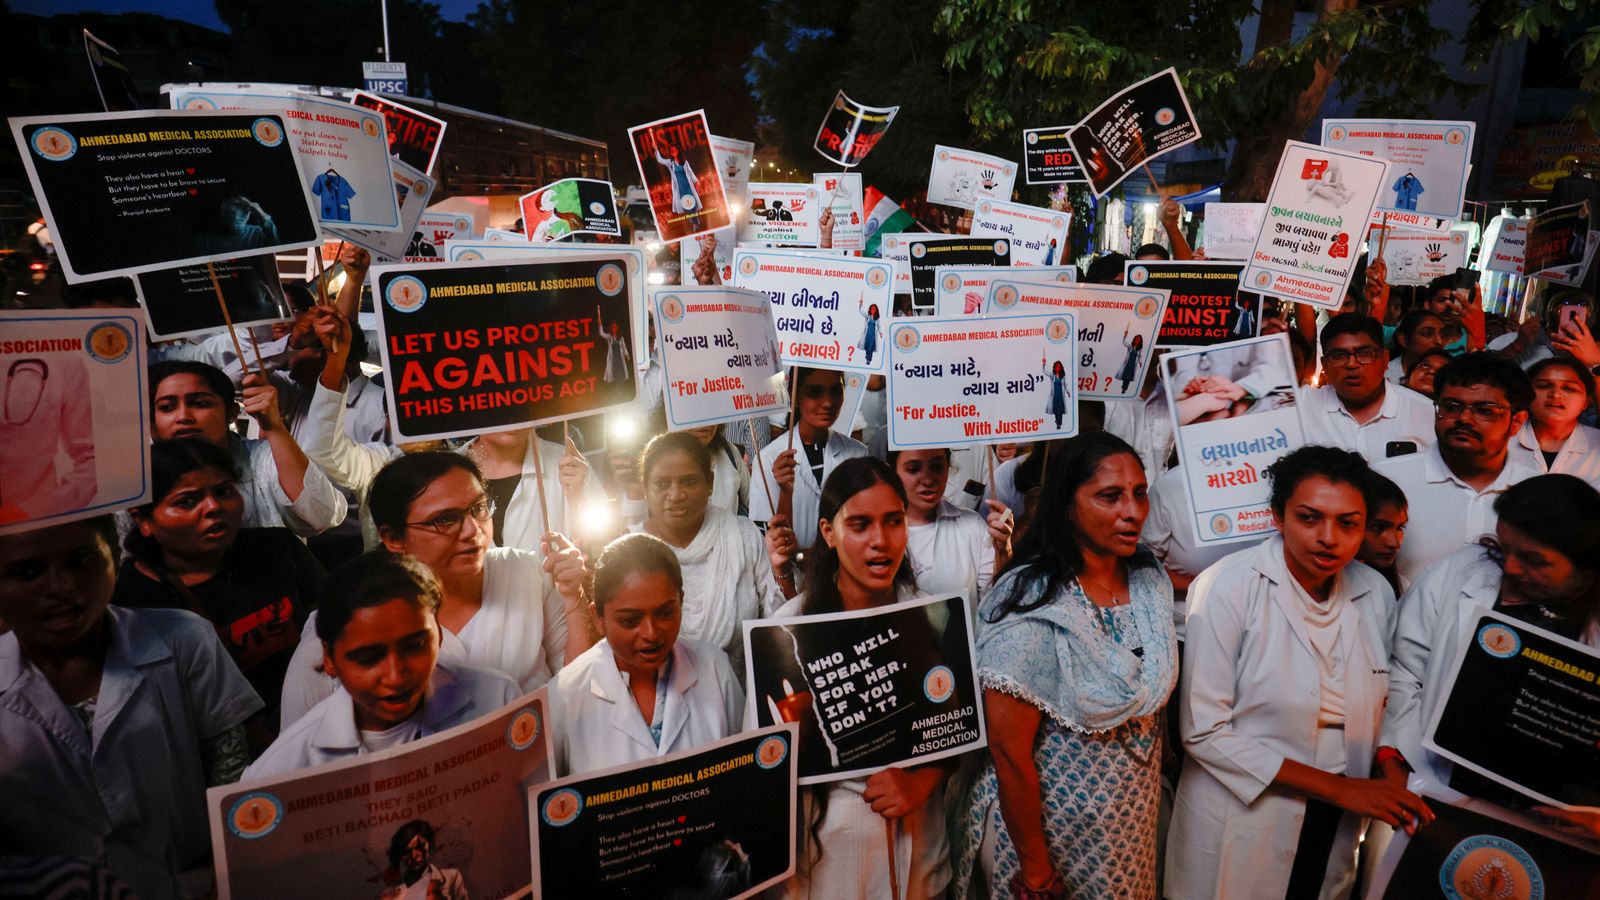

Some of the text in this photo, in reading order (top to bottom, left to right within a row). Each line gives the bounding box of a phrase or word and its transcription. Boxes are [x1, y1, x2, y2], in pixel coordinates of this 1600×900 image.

[368, 81, 404, 93] UPSC
[286, 110, 361, 130] EDICAL ASSOCIATION
[1097, 98, 1135, 138] WHO WILL
[79, 128, 252, 147] AHMEDABAD MEDICAL ASSOCIATION
[304, 131, 316, 140] put
[318, 131, 336, 141] down
[1102, 114, 1126, 144] SPEAK
[1106, 111, 1144, 149] FOR HER,
[1111, 122, 1140, 154] IF YOU
[1153, 121, 1190, 141] AHMEDABAD
[1160, 129, 1188, 144] MEDICAL
[1408, 132, 1443, 140] ASSOCIATION
[301, 138, 344, 151] Stethos and
[639, 120, 708, 160] JUSTICE
[1156, 130, 1196, 150] ASSOCIATION
[97, 147, 213, 162] Stop violence against DOCTORS.
[297, 146, 348, 160] Scalpels today
[1044, 154, 1072, 166] RED
[104, 174, 124, 183] They
[125, 172, 140, 181] also
[141, 171, 159, 179] have
[166, 168, 185, 176] heart
[108, 186, 122, 194] But
[123, 184, 140, 192] they
[140, 182, 159, 190] have
[168, 180, 178, 188] be
[178, 178, 198, 186] brave
[112, 190, 188, 204] Someone's heartbeat
[749, 220, 766, 228] Stop
[760, 264, 864, 280] AHMEDABAD MEDICAL ASSOCIATION
[1204, 272, 1238, 280] ASSOCIATION
[430, 276, 596, 298] AHMEDABAD MEDICAL ASSOCIATION
[1273, 284, 1330, 302] Medical Association
[1276, 275, 1334, 294] Ahmedabad
[686, 304, 742, 313] AHMEDABAD MEDICAL
[792, 288, 840, 310] બીજાની
[1020, 294, 1134, 311] AHMEDABAD MEDICAL ASSOCIATION
[1172, 295, 1232, 307] PROTEST
[777, 314, 814, 334] બચાવે
[1162, 308, 1231, 326] AINST
[390, 318, 593, 356] LET US PROTEST
[922, 327, 1045, 344] AHMEDABAD MEDICAL ASSOCIATION
[1160, 327, 1230, 338] EINOUS ACT
[790, 340, 855, 362] બચાવશે ?
[398, 342, 596, 395] AGAINST
[894, 362, 943, 379] “ન્યાય
[671, 376, 744, 397] “For Justice,
[962, 378, 999, 397] ન્યાય
[400, 376, 598, 418] THIS HEINOUS ACT
[732, 394, 754, 410] With
[896, 404, 980, 421] “For Justice,
[964, 418, 1044, 437] With Justice"
[1202, 428, 1288, 461] બચાવનારને
[1206, 462, 1258, 488] મારશો
[807, 628, 900, 675] WHO WILL
[814, 657, 874, 689] SPEAK
[1520, 647, 1595, 682] AHMEDABAD
[820, 660, 908, 704] FOR HER,
[825, 680, 894, 720] IF YOU
[830, 695, 898, 734] DON'T?
[912, 706, 974, 731] AHMEDABAD
[922, 721, 966, 740] MEDICAL
[912, 729, 978, 756] ASSOCIATION
[287, 736, 506, 814] AHMEDABAD MEDICAL ASSOCIATION
[586, 753, 754, 808] AHMEDABAD MEDICAL ASSOCIATION
[303, 771, 500, 844] BETI BACHAO BETI PADAO
[365, 783, 438, 814] THEY SAID
[598, 810, 616, 822] Stop
[616, 802, 644, 816] violence
[644, 798, 670, 810] against
